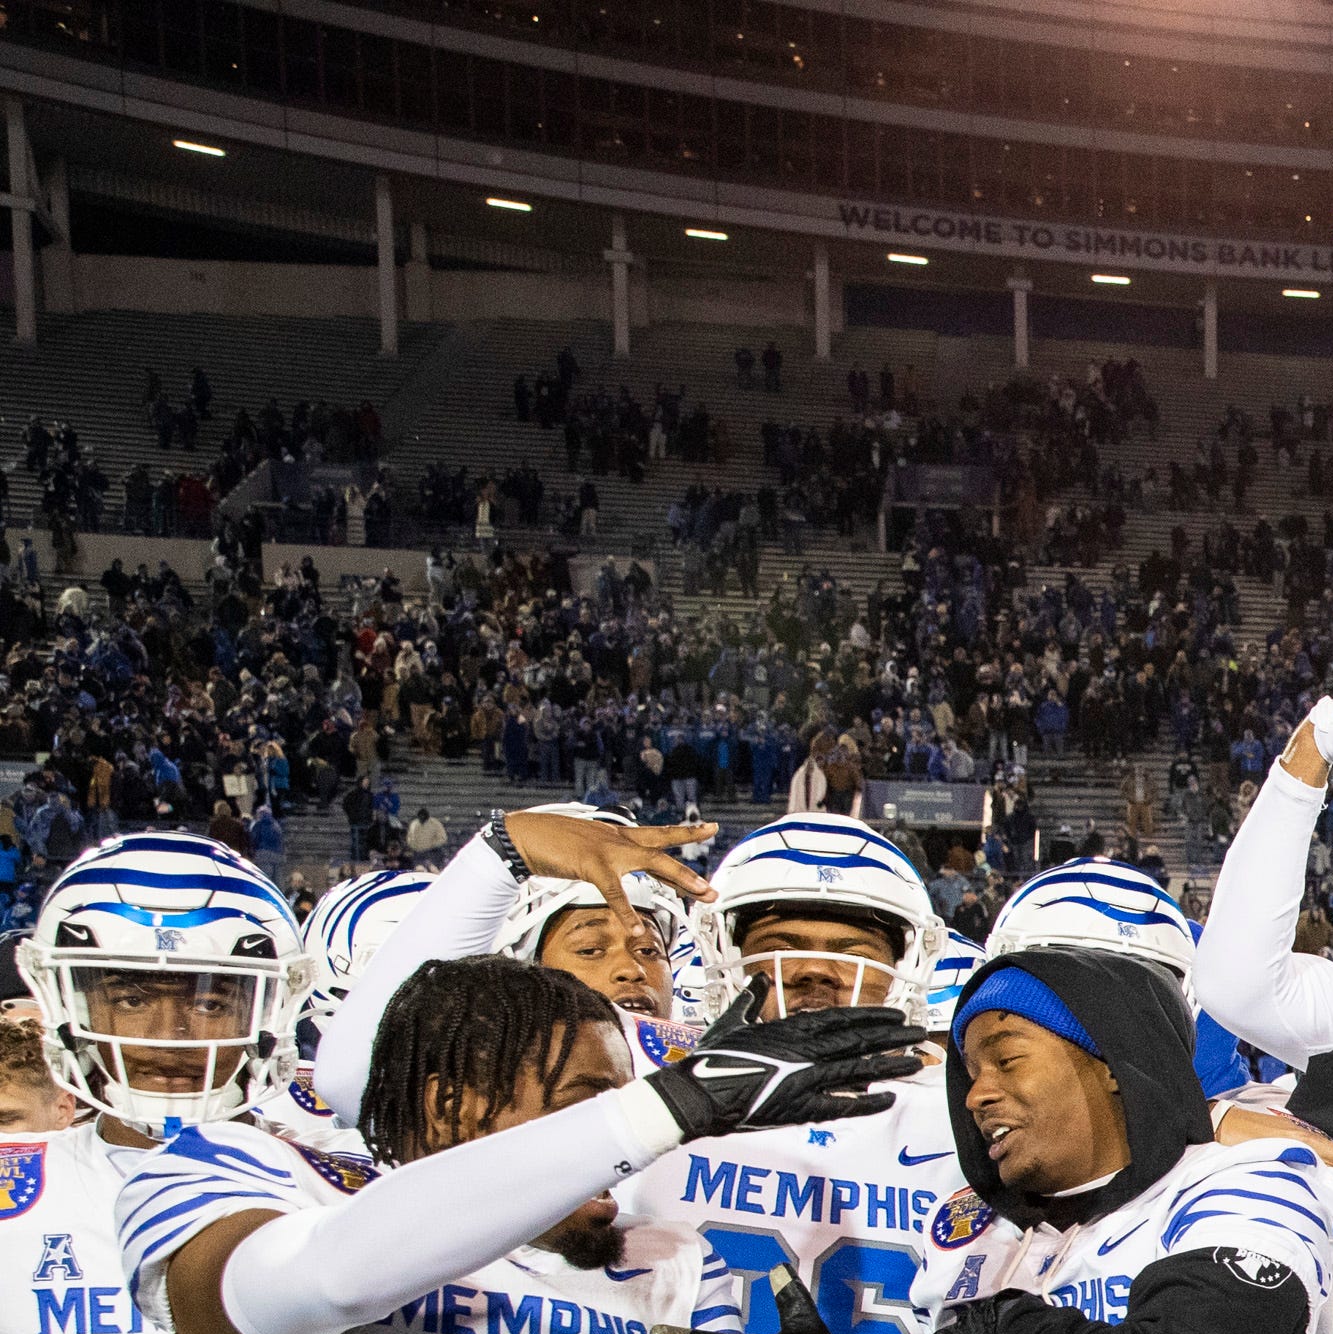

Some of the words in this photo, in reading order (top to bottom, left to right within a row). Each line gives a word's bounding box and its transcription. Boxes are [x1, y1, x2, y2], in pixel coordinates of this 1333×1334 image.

[839, 204, 1001, 245] WELCOME
[1012, 225, 1053, 248] TO
[1065, 231, 1211, 263] SIMMONS
[1218, 245, 1301, 270] BANK
[680, 1153, 938, 1233] MEMPHIS
